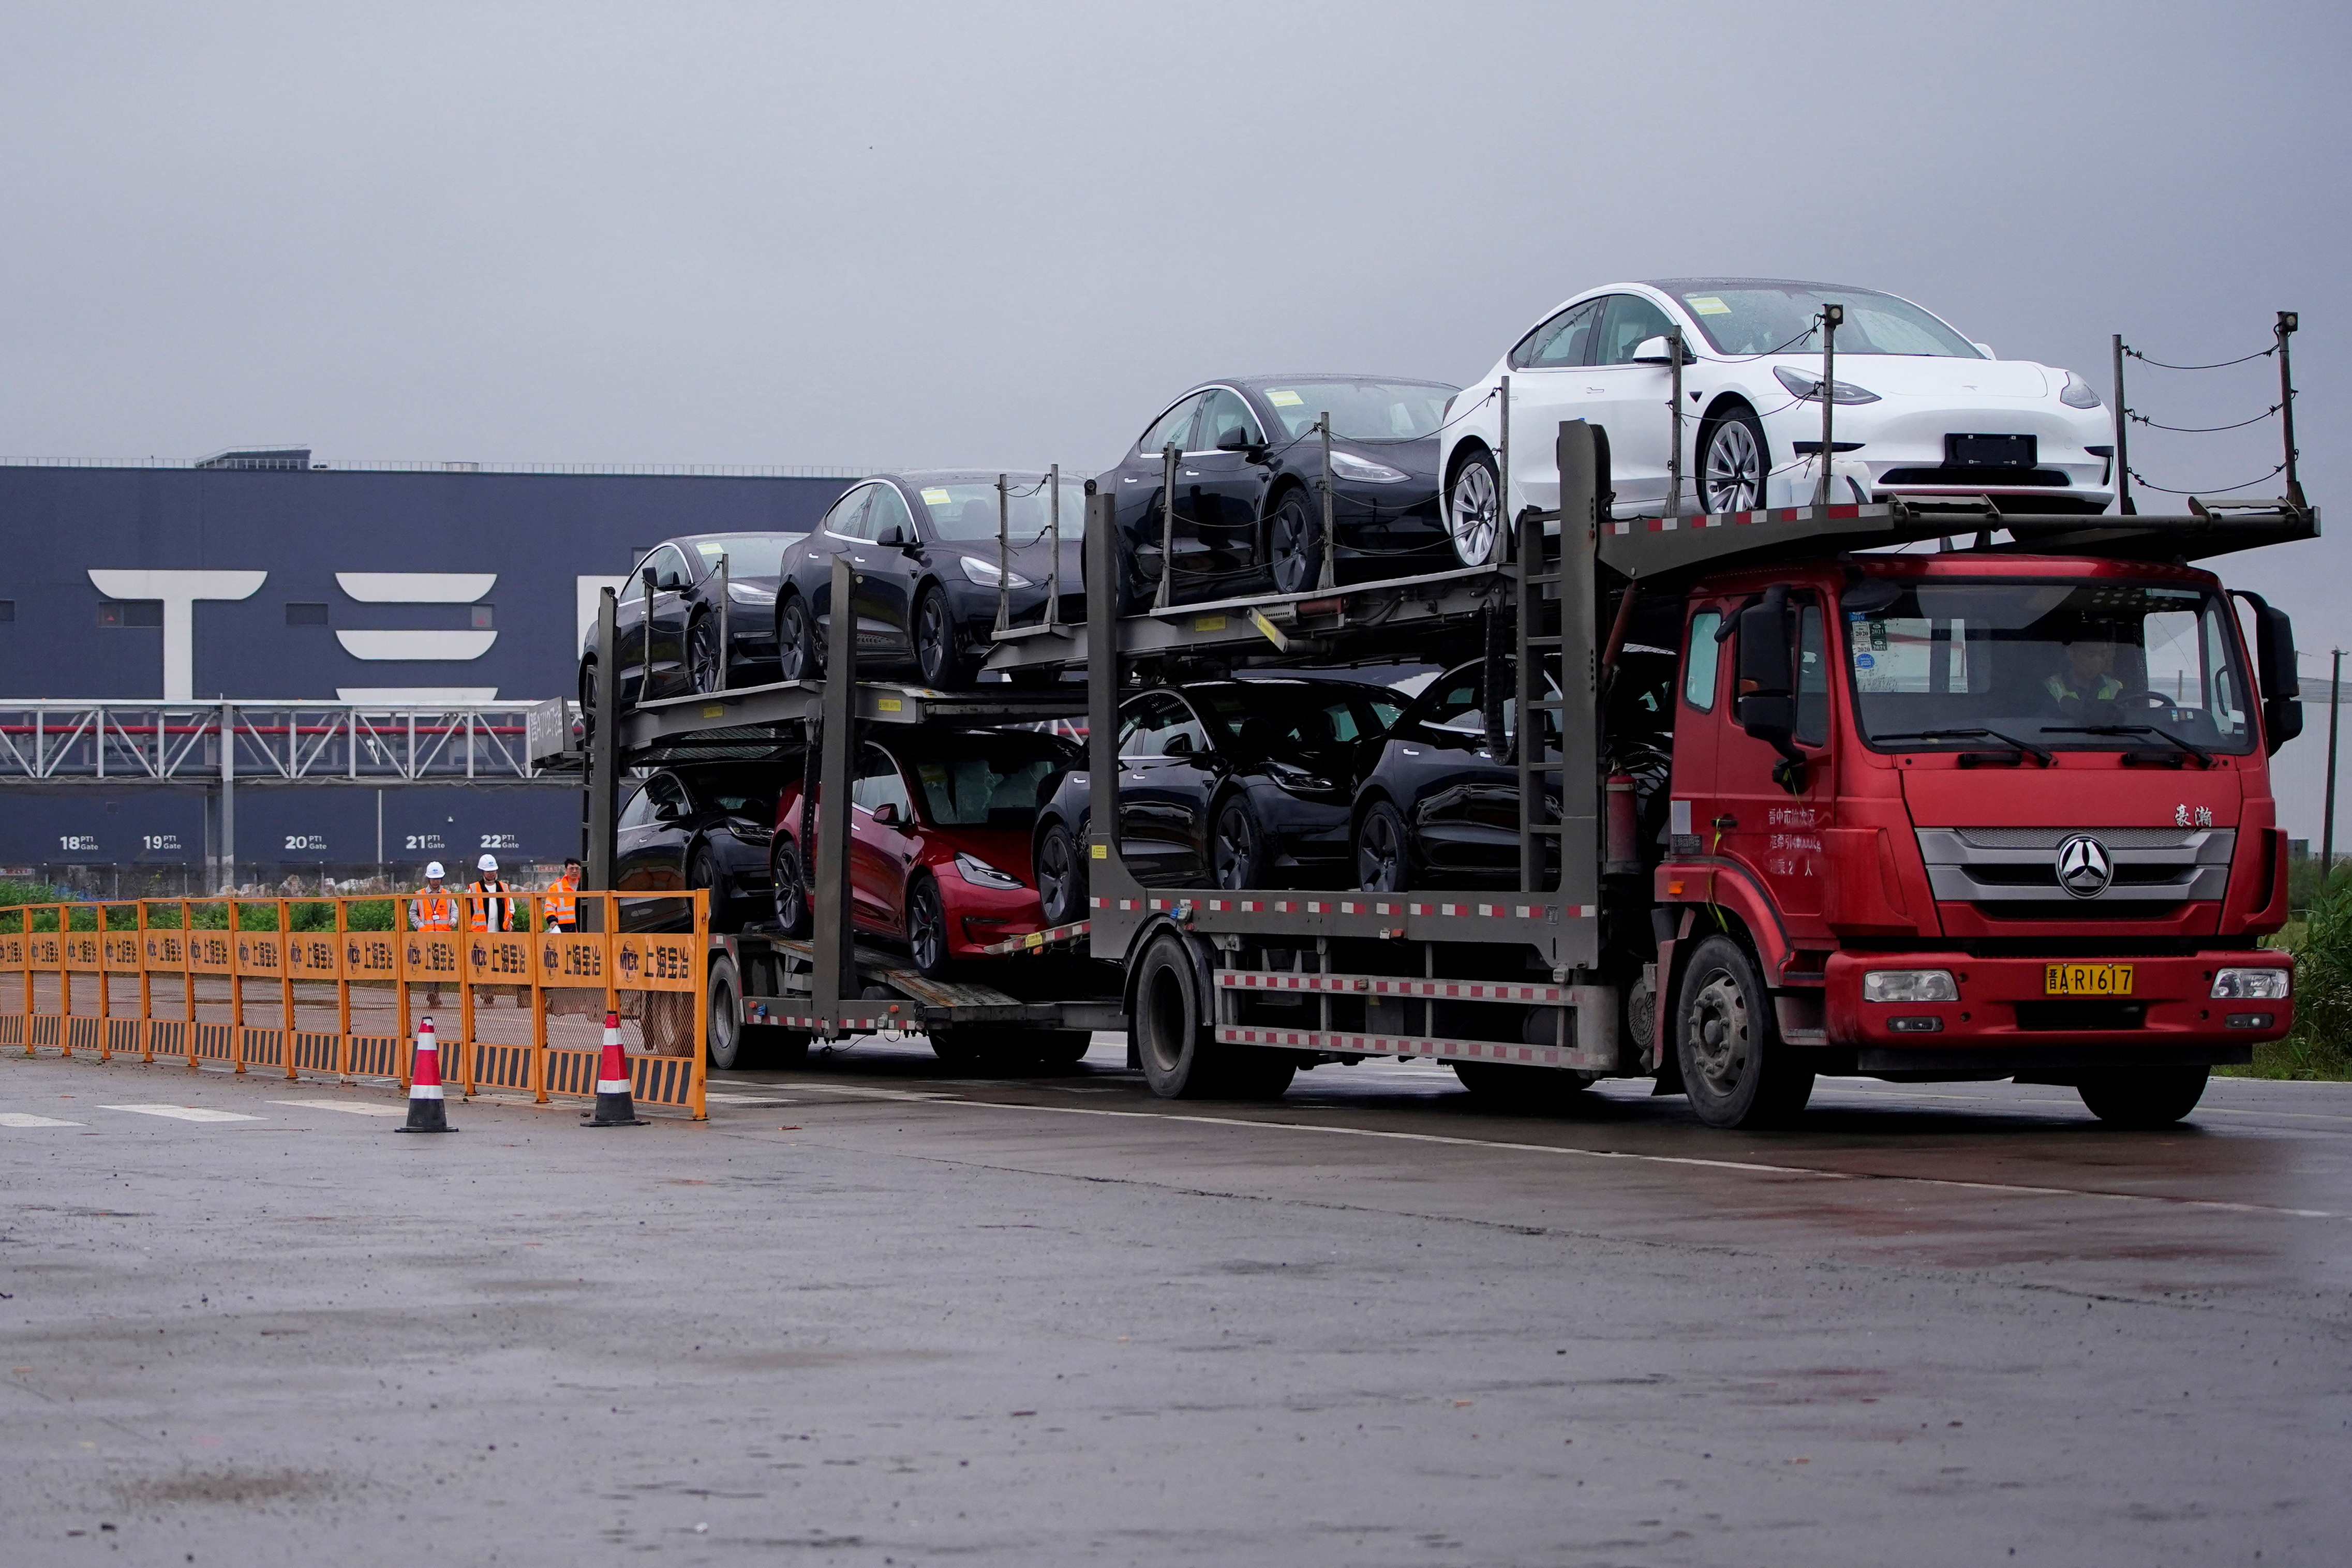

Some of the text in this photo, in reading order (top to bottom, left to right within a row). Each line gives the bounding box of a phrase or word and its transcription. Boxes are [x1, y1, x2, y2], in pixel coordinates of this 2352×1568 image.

[88, 569, 628, 716] TE
[2175, 803, 2212, 827] 豪瀚
[60, 836, 80, 849] 18
[143, 835, 162, 849] 19
[285, 835, 307, 849] 20
[406, 835, 425, 849] 21
[480, 834, 501, 848] 22
[407, 948, 421, 965] MCC
[471, 948, 487, 966] MCC
[491, 943, 525, 973] 上海宝冶
[544, 950, 558, 968] MCC
[564, 944, 601, 976] 上海宝冶
[620, 952, 638, 970] MCC
[644, 946, 689, 979] 上海宝冶
